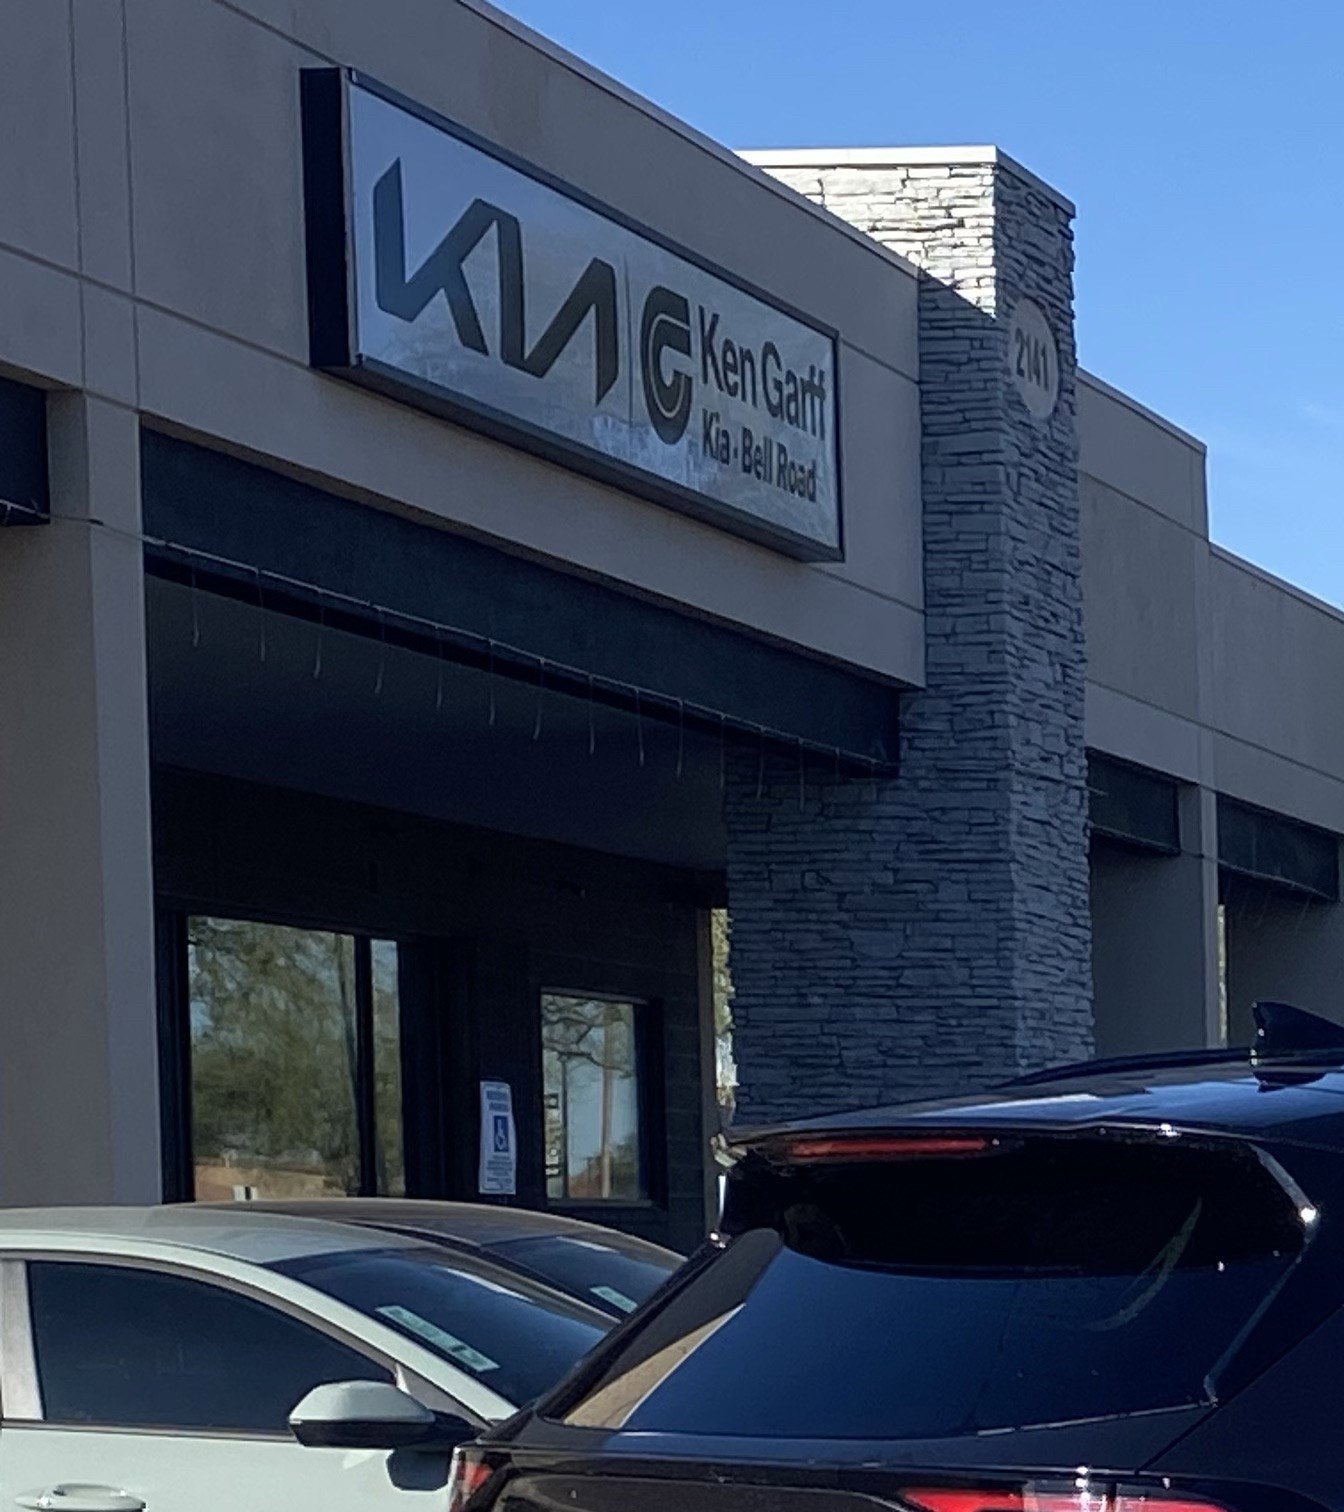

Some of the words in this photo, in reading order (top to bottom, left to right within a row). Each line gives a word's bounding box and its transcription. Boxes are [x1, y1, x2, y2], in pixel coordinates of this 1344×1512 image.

[372, 157, 620, 406] KIA
[699, 305, 758, 408] Ken
[762, 341, 826, 441] Garff
[702, 408, 730, 465] Kia
[742, 427, 773, 485] Bell
[777, 442, 817, 503] Road
